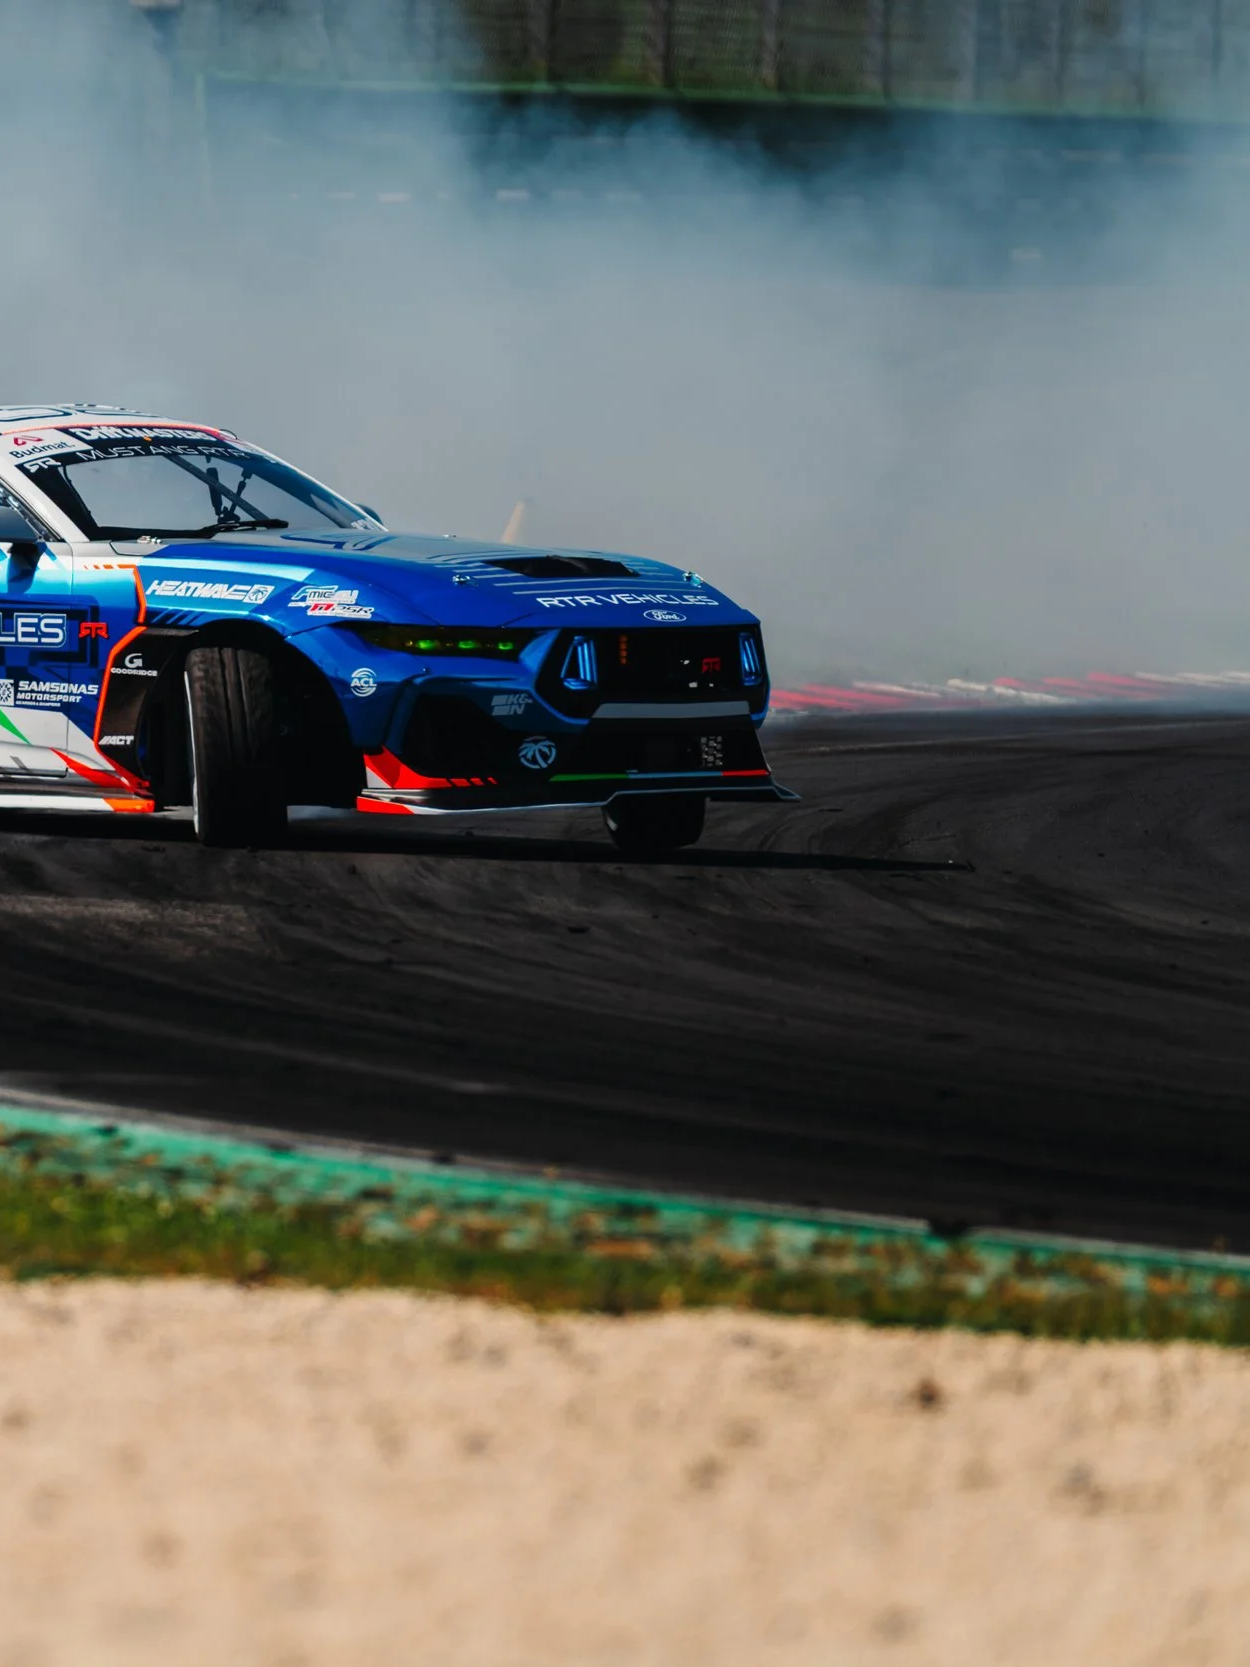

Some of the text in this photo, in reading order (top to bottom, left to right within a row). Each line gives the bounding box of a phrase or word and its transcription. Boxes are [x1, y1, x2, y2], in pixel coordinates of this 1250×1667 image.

[76, 445, 197, 460] MUSTANG
[146, 579, 252, 600] HEATWAVE
[536, 593, 720, 609] RTR VEHICLES
[651, 610, 681, 621] Ford
[110, 667, 159, 677] GOODRIDGE
[18, 680, 99, 696] SAMSONAS
[351, 677, 378, 687] ACL
[16, 691, 83, 703] MOTORSPORT
